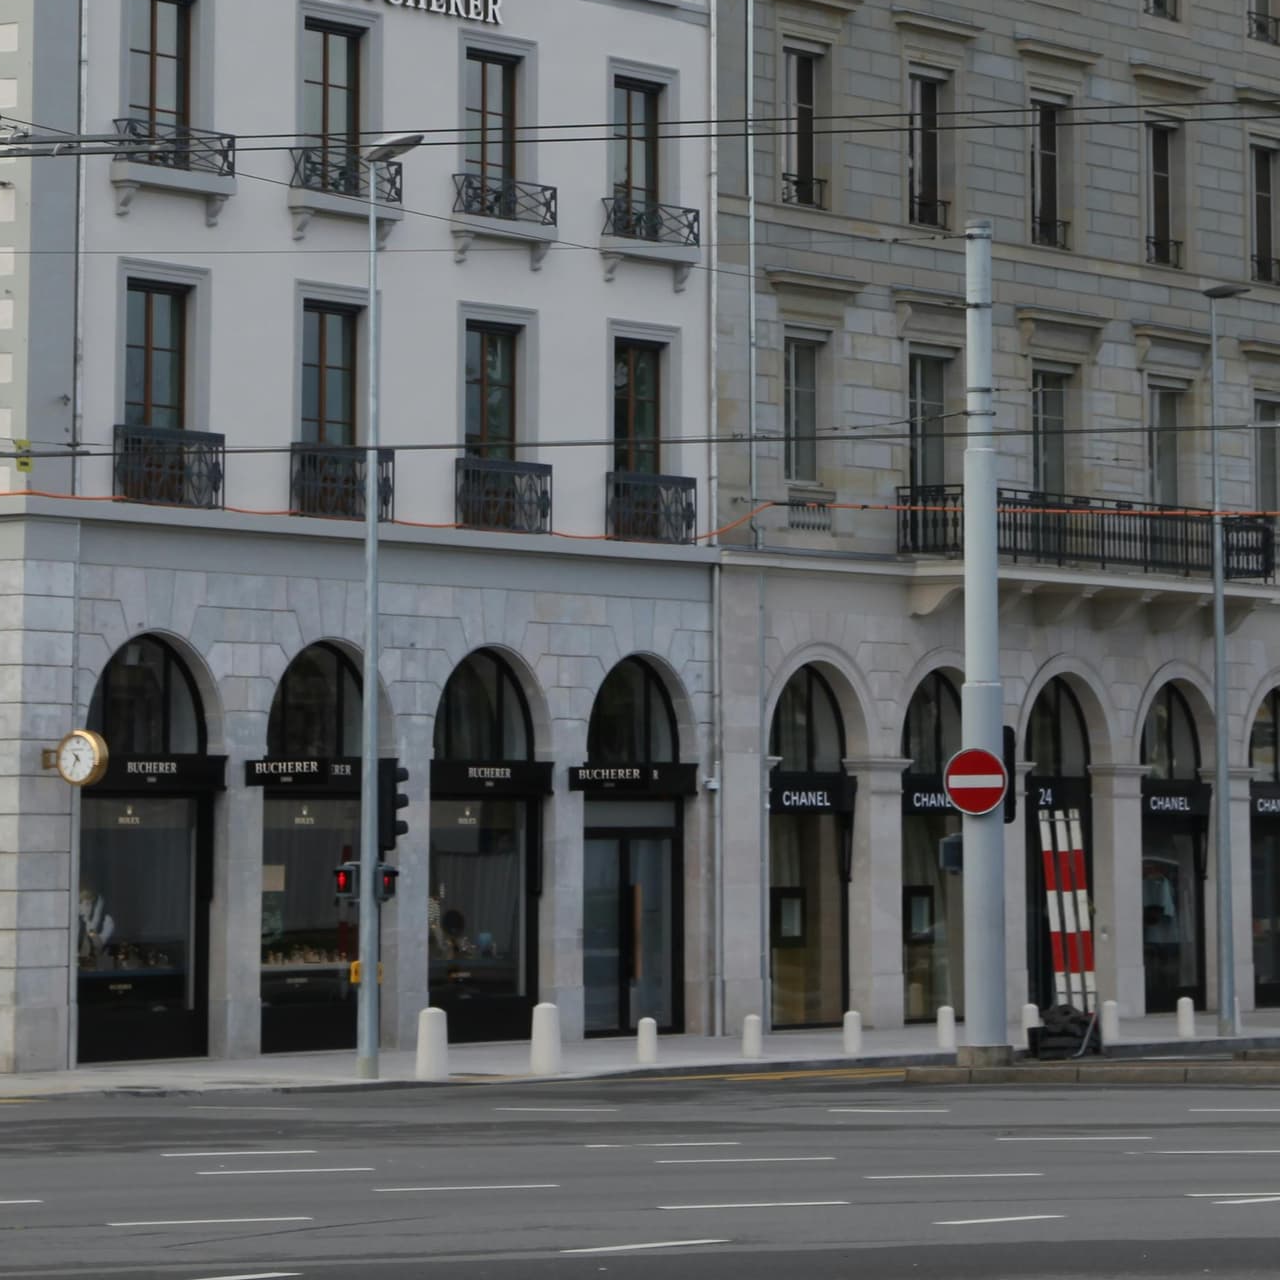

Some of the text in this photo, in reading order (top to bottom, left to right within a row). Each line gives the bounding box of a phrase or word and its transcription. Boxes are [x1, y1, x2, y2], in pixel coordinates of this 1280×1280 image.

[127, 761, 178, 775] BUCHERER
[255, 761, 320, 775] BUCHERER
[467, 767, 512, 779] BUCHERER
[578, 768, 641, 780] BUCHERER
[782, 790, 832, 807] CHANEL
[1039, 788, 1053, 806] 24
[1150, 796, 1191, 812] CHANEL
